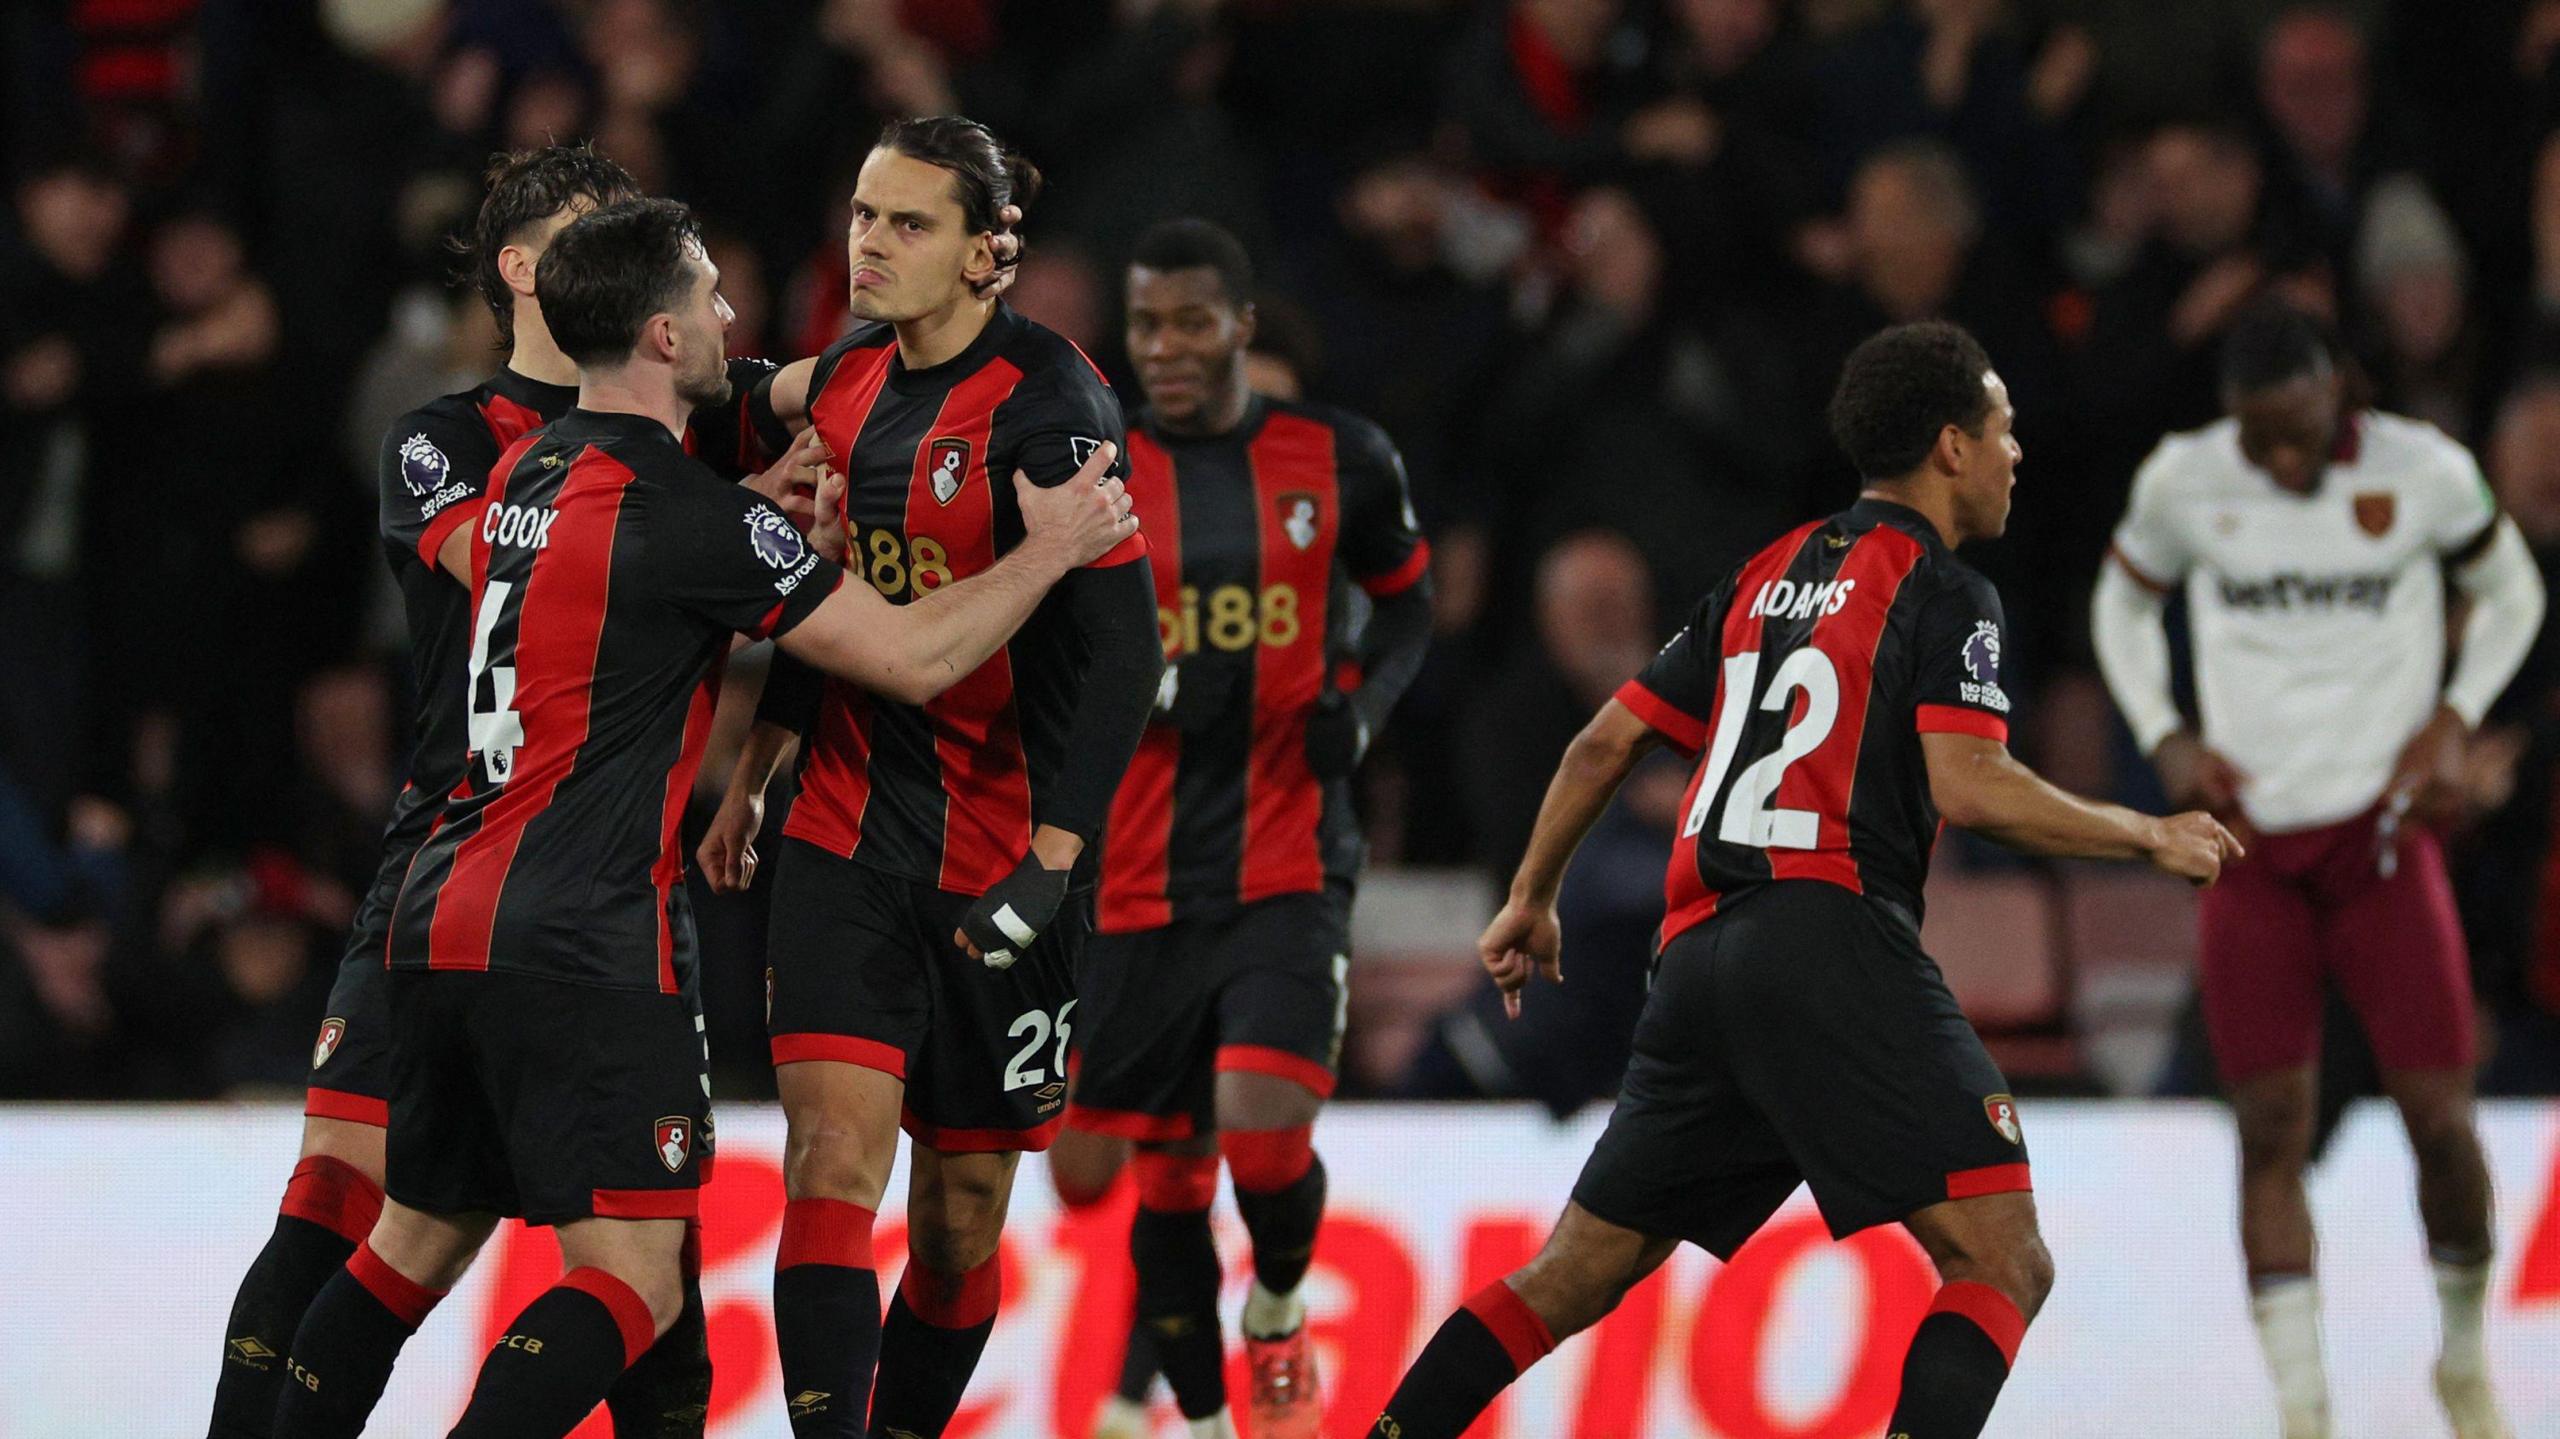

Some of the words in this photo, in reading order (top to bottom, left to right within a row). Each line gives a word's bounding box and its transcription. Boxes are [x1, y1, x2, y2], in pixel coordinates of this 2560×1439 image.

[483, 501, 559, 548] COOK
[774, 575, 796, 593] No
[846, 519, 954, 598] i88
[1748, 579, 1855, 619] ADAMS
[2216, 568, 2396, 620] betway
[467, 580, 525, 783] 4
[1960, 682, 1981, 695] No
[1682, 647, 1840, 850] 12
[476, 1155, 1950, 1439] Btano
